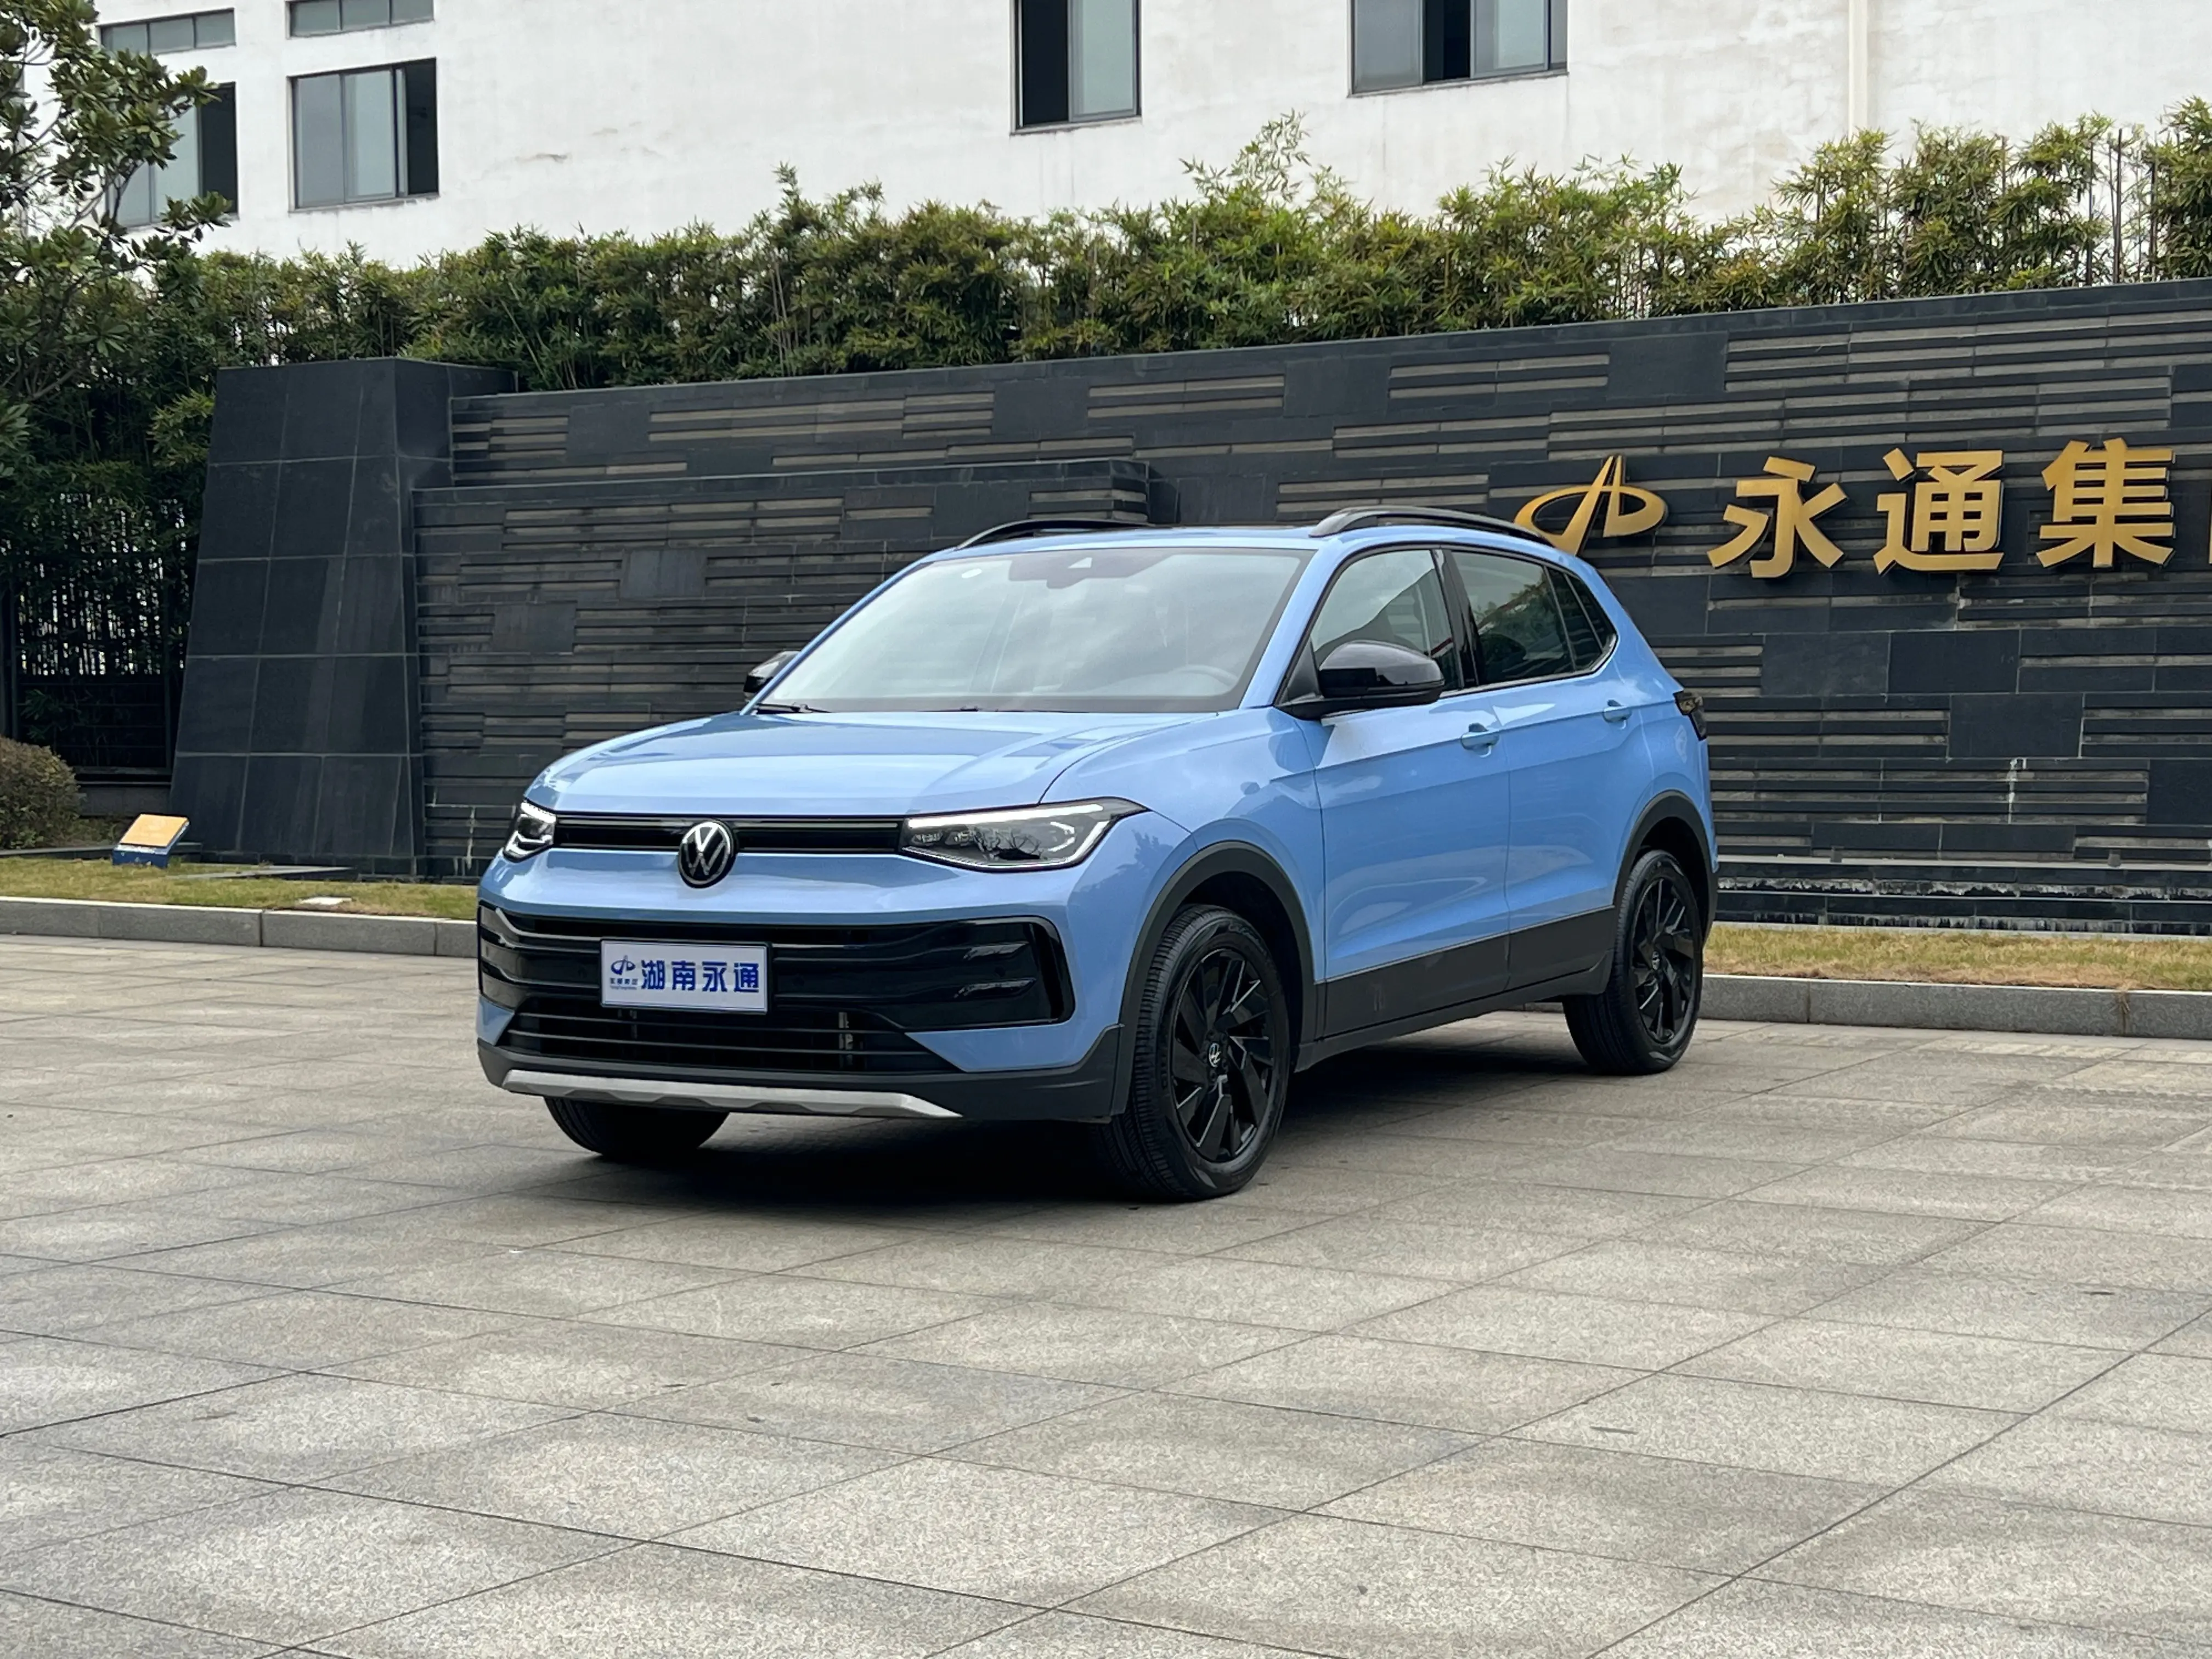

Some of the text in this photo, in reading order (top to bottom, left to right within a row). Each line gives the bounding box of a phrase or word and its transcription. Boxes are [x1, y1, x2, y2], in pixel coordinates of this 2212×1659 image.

[1706, 438, 2212, 579] 永通集
[682, 824, 729, 879] VW
[640, 960, 759, 993] 湖南永通
